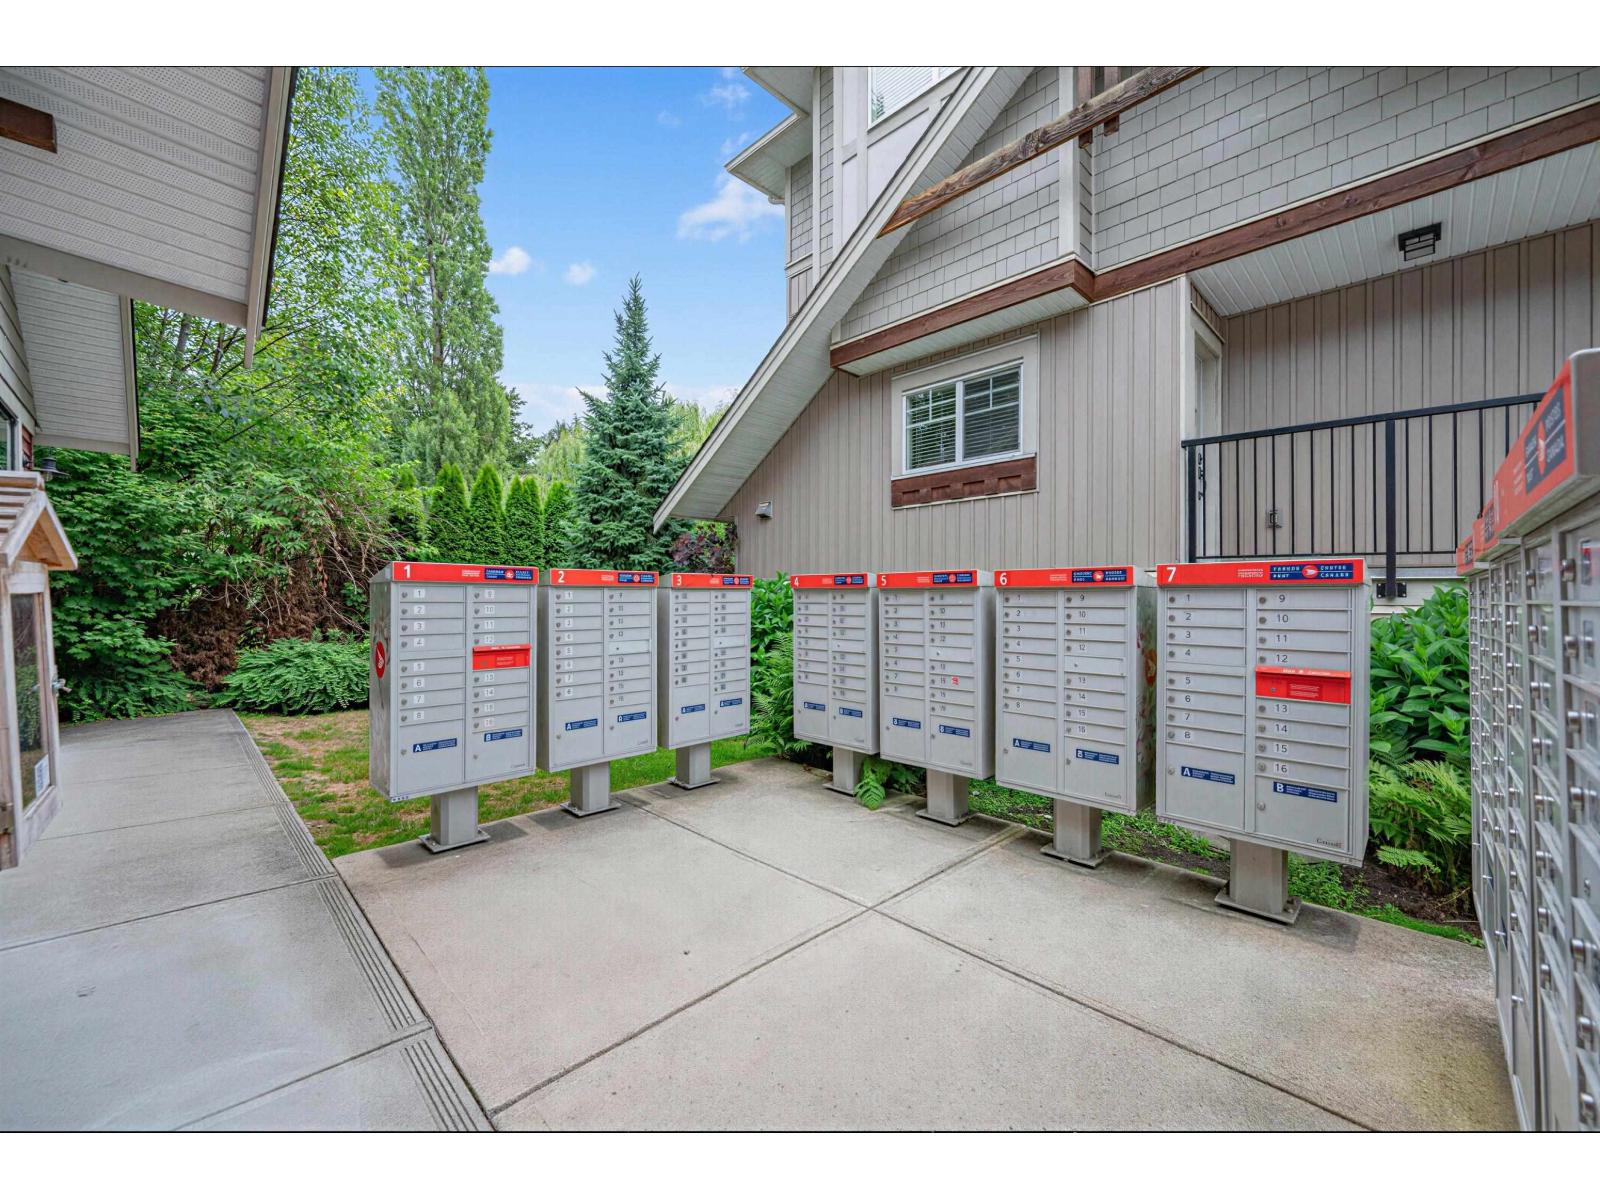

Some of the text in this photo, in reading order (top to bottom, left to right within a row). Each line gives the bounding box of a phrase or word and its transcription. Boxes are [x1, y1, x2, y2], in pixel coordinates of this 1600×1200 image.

[403, 564, 411, 578] 1
[1166, 566, 1177, 582] 7
[558, 570, 565, 583] 2
[676, 574, 682, 586] 3
[881, 575, 887, 586] 5
[999, 572, 1007, 585] 6
[793, 577, 799, 586] 4
[1279, 594, 1286, 603] 9
[1079, 610, 1086, 618] 10
[1185, 612, 1192, 621] 2
[1277, 614, 1289, 623] 10
[1079, 627, 1086, 635] 11
[1185, 630, 1191, 639] 3
[1276, 634, 1288, 643] 11
[1184, 649, 1191, 657] 4
[1276, 654, 1289, 663] 12
[1185, 676, 1191, 685] 5
[1184, 694, 1191, 703] 6
[1275, 703, 1288, 713] 13
[1184, 712, 1191, 721] 7
[1275, 723, 1288, 733] 14
[1275, 743, 1288, 753] 15
[1183, 767, 1191, 777] A
[1275, 763, 1288, 773] 16
[1276, 783, 1284, 793] B
